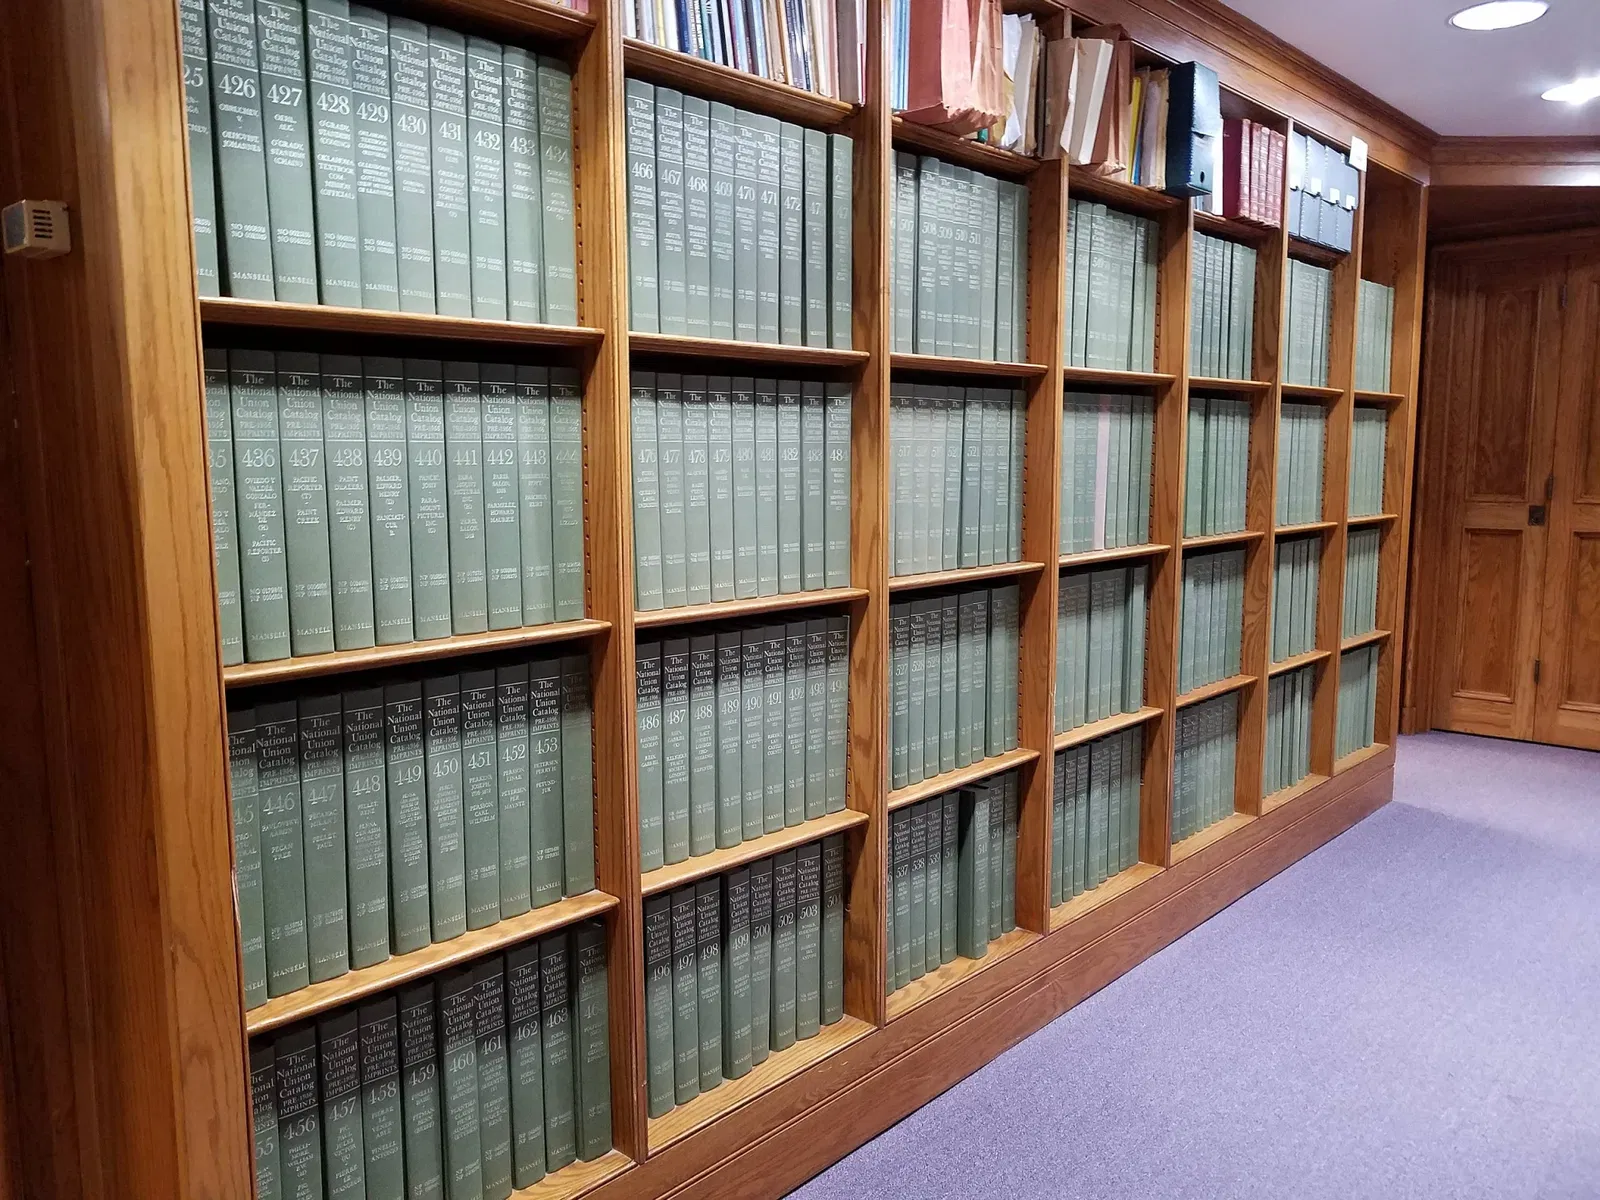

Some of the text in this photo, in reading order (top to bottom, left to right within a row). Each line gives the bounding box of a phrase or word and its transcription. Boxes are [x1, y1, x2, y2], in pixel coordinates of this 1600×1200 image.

[268, 6, 290, 20] The
[258, 15, 300, 34] National
[265, 28, 296, 45] Union
[262, 40, 300, 59] Catalog
[401, 41, 420, 54] The
[391, 50, 428, 67] National
[398, 62, 424, 78] Union
[477, 59, 495, 73] The
[183, 64, 204, 87] 25
[394, 72, 427, 91] Catalog
[469, 68, 502, 85] National
[219, 74, 255, 98] 426
[474, 80, 498, 94] Union
[267, 84, 302, 107] 427
[471, 90, 501, 107] Catalog
[316, 92, 350, 115] 428
[356, 102, 388, 123] 429
[397, 114, 427, 135] 430
[439, 121, 461, 141] 431
[474, 130, 500, 150] 432
[510, 137, 536, 157] 433
[632, 162, 653, 179] 466
[661, 169, 681, 185] 467
[687, 176, 707, 192] 468
[714, 181, 732, 196] 469
[737, 186, 755, 201] 470
[761, 190, 777, 205] 471
[784, 196, 801, 211] 472
[900, 219, 913, 232] 507
[922, 222, 937, 235] 508
[938, 227, 952, 239] 509
[969, 232, 980, 244] 511
[233, 272, 271, 282] MANSELL
[279, 275, 315, 285] MANSELL
[243, 374, 264, 384] The
[289, 375, 309, 386] The
[376, 380, 395, 390] The
[232, 385, 275, 396] National
[280, 387, 320, 397] National
[367, 390, 403, 400] National
[490, 385, 507, 394] The
[240, 397, 270, 408] Union
[286, 398, 315, 408] Union
[373, 401, 399, 411] Union
[482, 395, 515, 403] National
[236, 409, 274, 421] Catalog
[283, 409, 319, 420] Catalog
[487, 405, 510, 414] Union
[369, 411, 401, 423] Catalog
[485, 414, 514, 425] Catalog
[242, 448, 275, 469] 436
[289, 448, 319, 467] 437
[333, 448, 363, 467] 438
[374, 448, 402, 467] 439
[415, 449, 442, 465] 440
[453, 450, 478, 465] 441
[487, 450, 514, 465] 442
[523, 450, 546, 465] 443
[663, 450, 680, 463] 477
[689, 450, 706, 463] 478
[782, 448, 798, 460] 482
[297, 627, 331, 635] MANSELL
[340, 622, 372, 631] MANSELL
[665, 664, 688, 674] National
[896, 664, 908, 676] 527
[912, 660, 924, 672] 528
[539, 681, 553, 689] The
[666, 682, 687, 690] Catalog
[810, 682, 825, 696] 493
[470, 692, 486, 700] The
[531, 689, 560, 699] National
[767, 692, 782, 706] 491
[789, 687, 804, 700] 492
[396, 704, 413, 713] The
[463, 700, 494, 712] National
[535, 699, 556, 707] Union
[722, 699, 739, 715] 489
[745, 696, 761, 711] 490
[355, 711, 373, 721] The
[387, 712, 422, 725] National
[467, 711, 490, 720] Union
[532, 707, 558, 717] Catalog
[667, 710, 686, 724] 487
[694, 705, 712, 720] 488
[346, 720, 382, 733] National
[393, 724, 418, 734] Union
[464, 719, 493, 730] Catalog
[640, 714, 659, 731] 486
[266, 726, 286, 736] The
[352, 732, 378, 742] Union
[390, 732, 421, 744] Catalog
[256, 733, 296, 748] National
[349, 741, 381, 753] Catalog
[464, 736, 494, 745] IMPRINTS
[535, 737, 558, 755] 453
[262, 747, 291, 758] Union
[391, 749, 422, 761] IMPRINTS
[502, 744, 526, 762] 452
[259, 756, 295, 769] Catalog
[468, 752, 491, 769] 451
[433, 758, 459, 778] 450
[260, 774, 297, 787] IMPRINTS
[394, 765, 422, 786] 449
[352, 775, 381, 796] 448
[308, 784, 337, 805] 447
[263, 792, 295, 815] 446
[798, 866, 820, 875] National
[896, 864, 908, 878] 537
[912, 858, 924, 871] 538
[536, 881, 561, 892] MANSELL
[778, 912, 794, 927] 502
[800, 905, 818, 920] 503
[753, 924, 770, 939] 500
[733, 933, 748, 950] 499
[701, 943, 718, 960] 498
[677, 953, 694, 970] 497
[273, 962, 306, 977] MANSELL
[652, 963, 670, 981] 496
[546, 1007, 568, 1028] 463
[370, 1023, 388, 1034] The
[514, 1021, 538, 1041] 462
[361, 1030, 397, 1048] National
[482, 1035, 503, 1056] 461
[367, 1040, 393, 1054] Union
[286, 1053, 306, 1066] The
[364, 1050, 396, 1065] Catalog
[450, 1051, 475, 1074] 460
[277, 1059, 316, 1080] National
[408, 1063, 436, 1087] 459
[283, 1072, 311, 1088] Union
[280, 1080, 314, 1099] Catalog
[368, 1081, 397, 1105] 458
[329, 1096, 356, 1122] 457
[284, 1115, 316, 1140] 456
